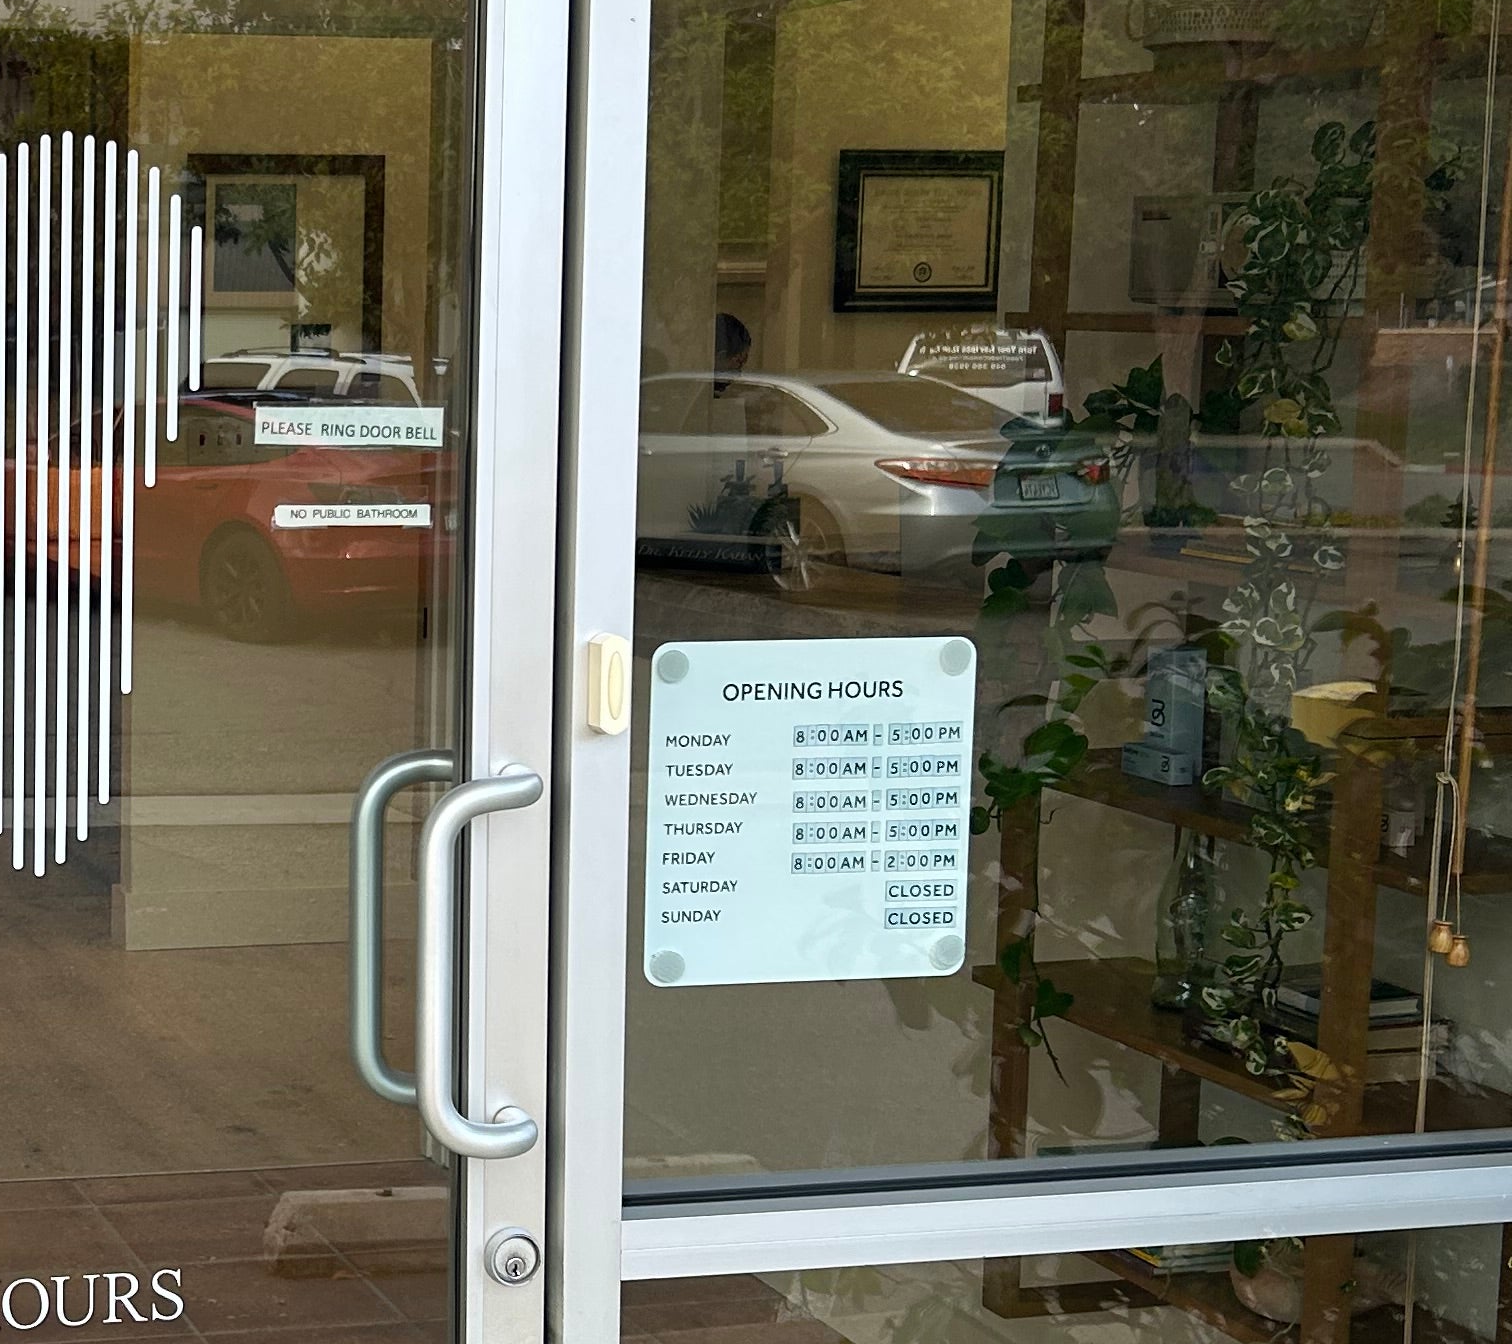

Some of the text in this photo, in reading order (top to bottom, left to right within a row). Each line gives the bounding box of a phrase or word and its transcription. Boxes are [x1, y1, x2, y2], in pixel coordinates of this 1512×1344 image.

[261, 421, 437, 440] PLEASE RING DOOR BELL
[290, 509, 418, 519] NO PUBLIC BATHROOM
[722, 680, 903, 701] OPENING HOURS
[665, 734, 731, 748] MONDAY
[796, 729, 839, 744] 8:00
[844, 729, 868, 743] AM
[892, 727, 933, 741] 5:00
[938, 726, 961, 740] PM
[666, 763, 734, 777] TUESDAY
[795, 762, 838, 776] 8:00
[842, 761, 867, 775] AM
[890, 760, 931, 775] 5:00
[937, 760, 959, 773] PM
[664, 791, 758, 807] WEDNESDAY
[795, 796, 838, 809] 8:00
[842, 795, 866, 808] AM
[889, 792, 931, 806] 5:00
[936, 792, 958, 805] PM
[664, 821, 743, 836] THURSDAY
[795, 827, 838, 840] 8:00
[842, 826, 866, 840] AM
[888, 824, 930, 838] 5:00
[935, 824, 957, 837] PM
[662, 851, 715, 865] FRIDAY
[794, 856, 837, 870] 8:00
[841, 856, 865, 869] AM
[887, 854, 929, 869] 2:00
[933, 854, 955, 868] PM
[662, 880, 954, 898] SATURDAY CLOSED
[661, 910, 954, 925] SUNDAY CLOSED
